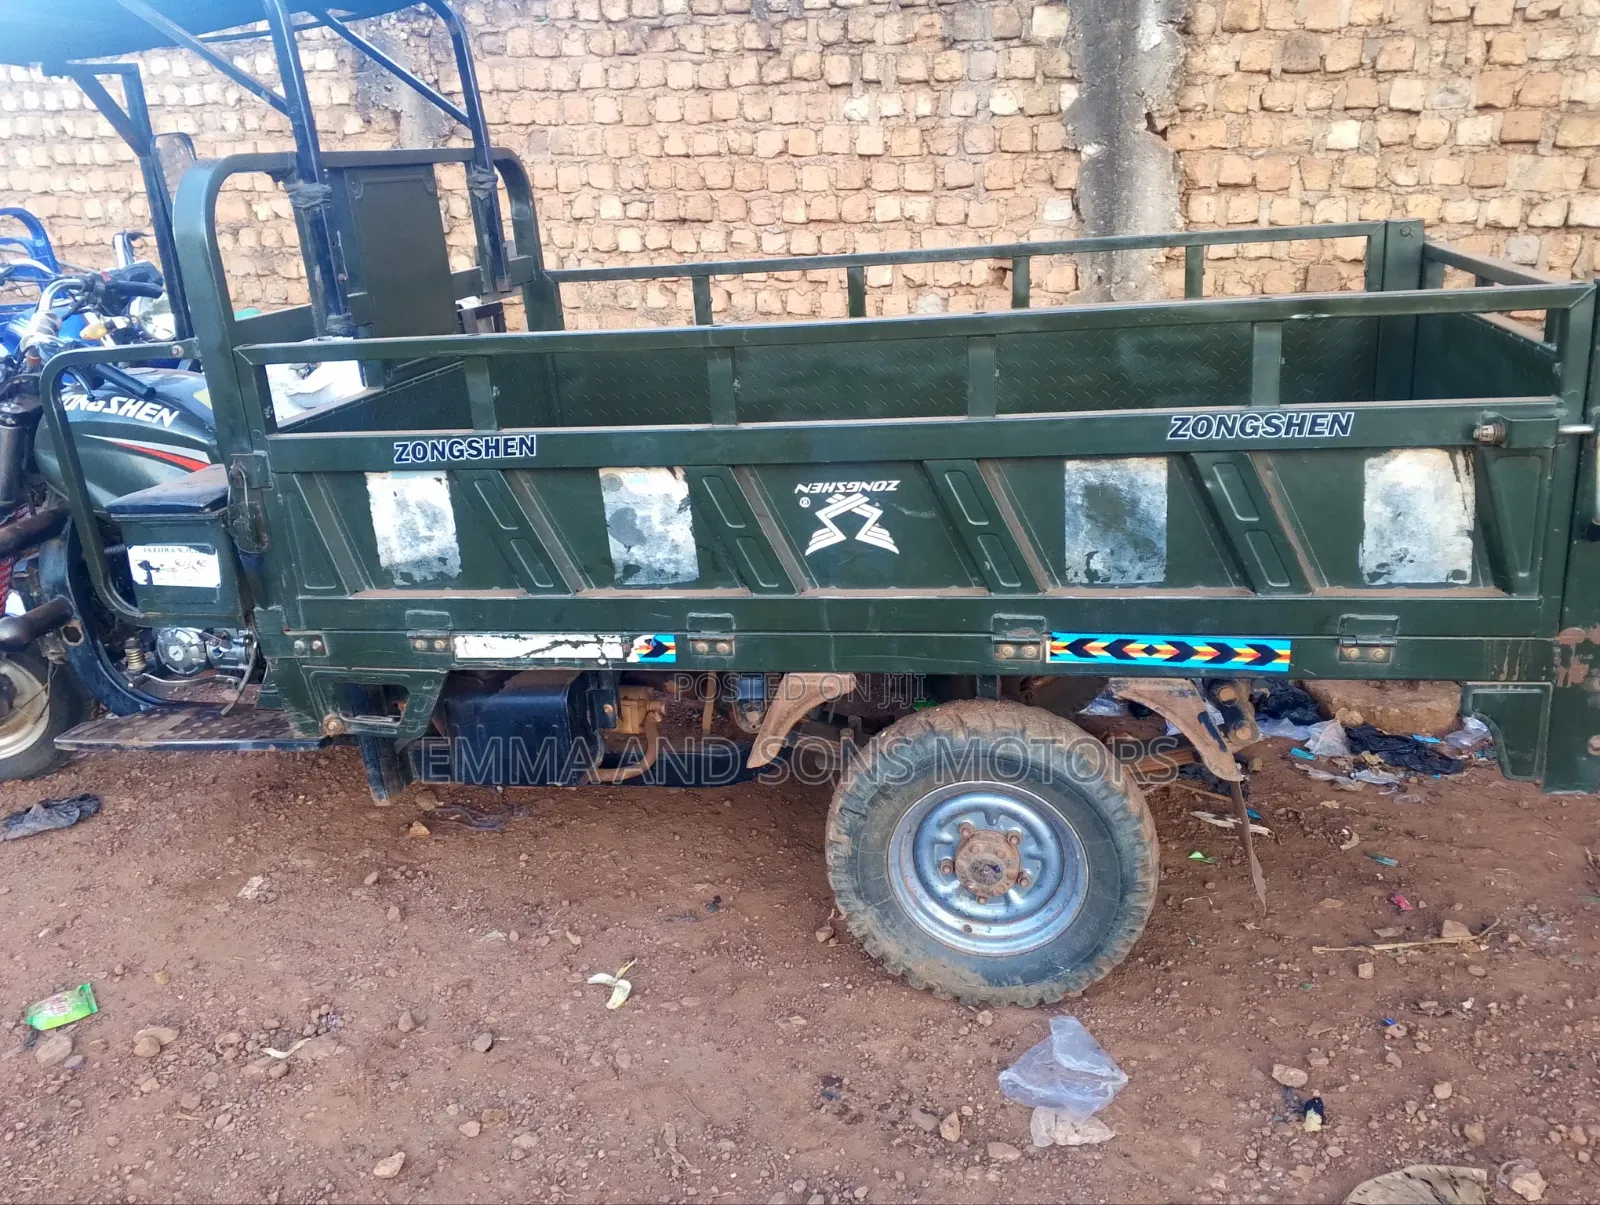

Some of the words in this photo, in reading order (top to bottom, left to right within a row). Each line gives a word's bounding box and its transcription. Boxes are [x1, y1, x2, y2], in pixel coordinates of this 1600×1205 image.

[61, 393, 180, 428] ONGSHEN
[1167, 412, 1354, 441] ZONGSHEN
[393, 435, 537, 464] ZONGSHEN
[794, 480, 901, 494] ZONGSHEN
